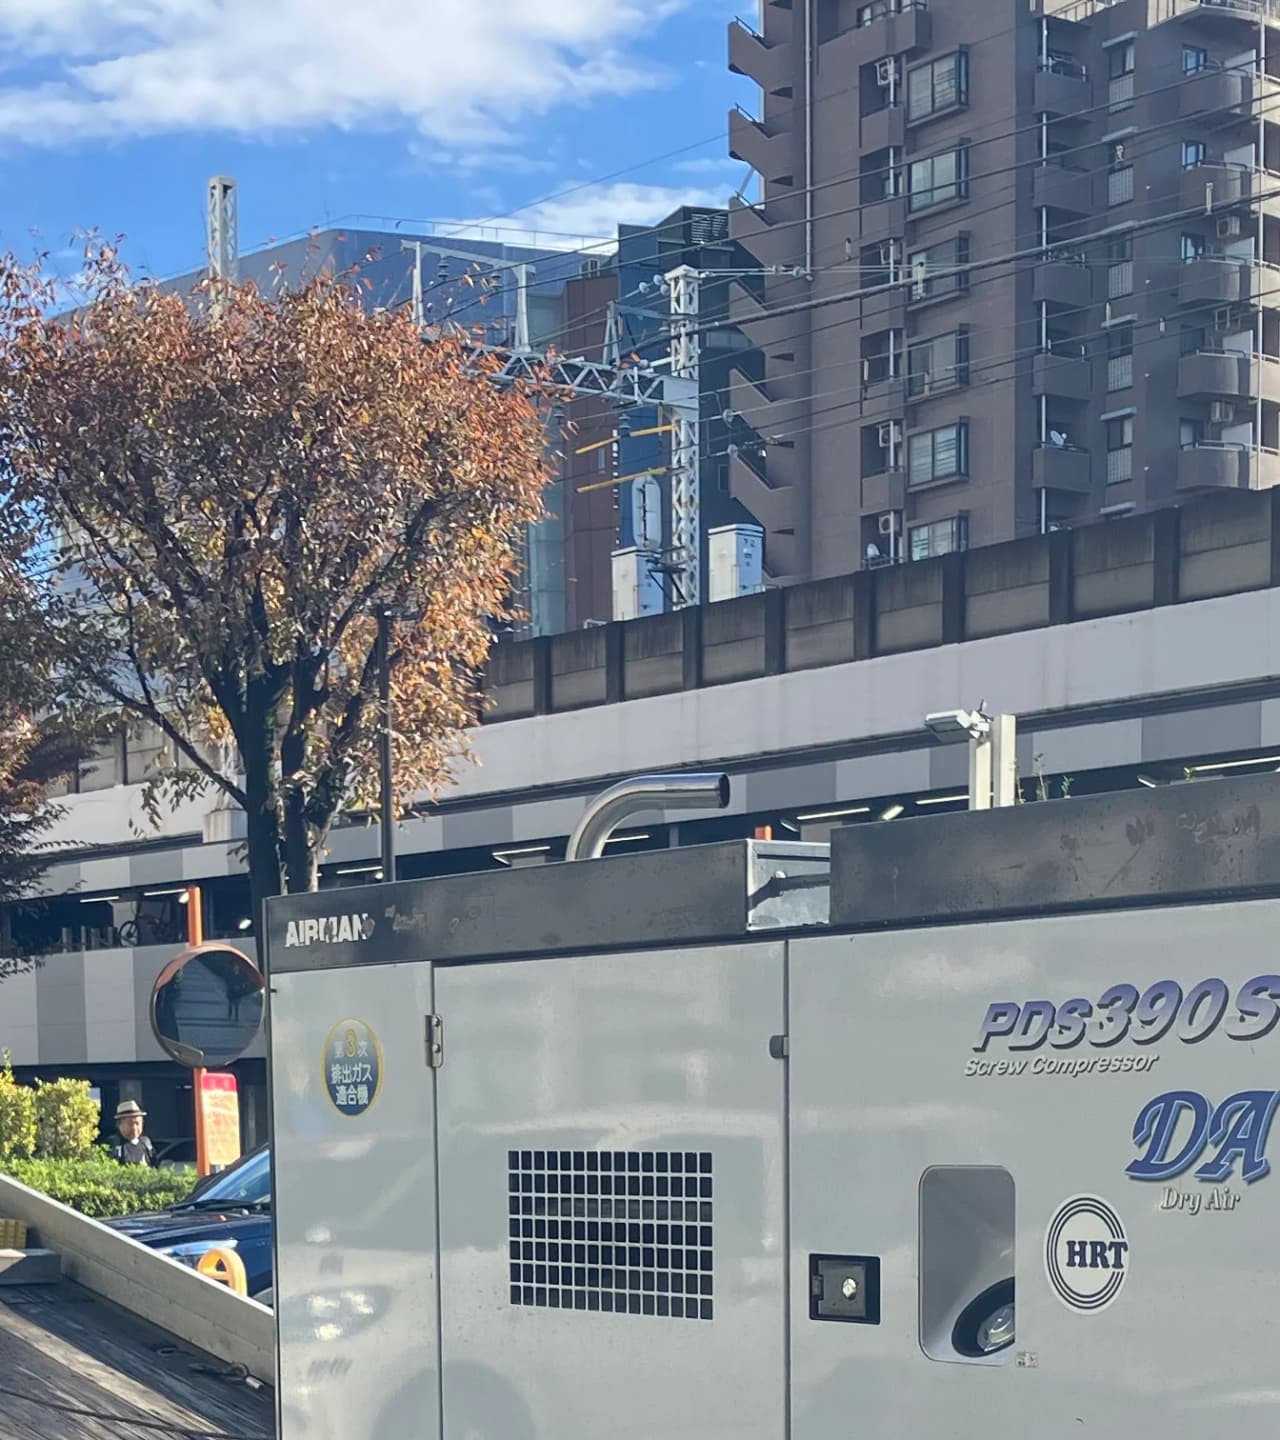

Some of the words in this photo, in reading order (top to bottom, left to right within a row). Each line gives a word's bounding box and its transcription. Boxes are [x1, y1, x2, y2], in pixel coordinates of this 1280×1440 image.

[331, 1062, 373, 1084] 排出ガス
[964, 1056, 1027, 1077] Screw
[1030, 1054, 1160, 1078] Compressor
[336, 1084, 368, 1105] 適合機
[1160, 1187, 1201, 1216] Dry
[1204, 1187, 1241, 1211] Air
[1066, 1240, 1129, 1269] HRT
